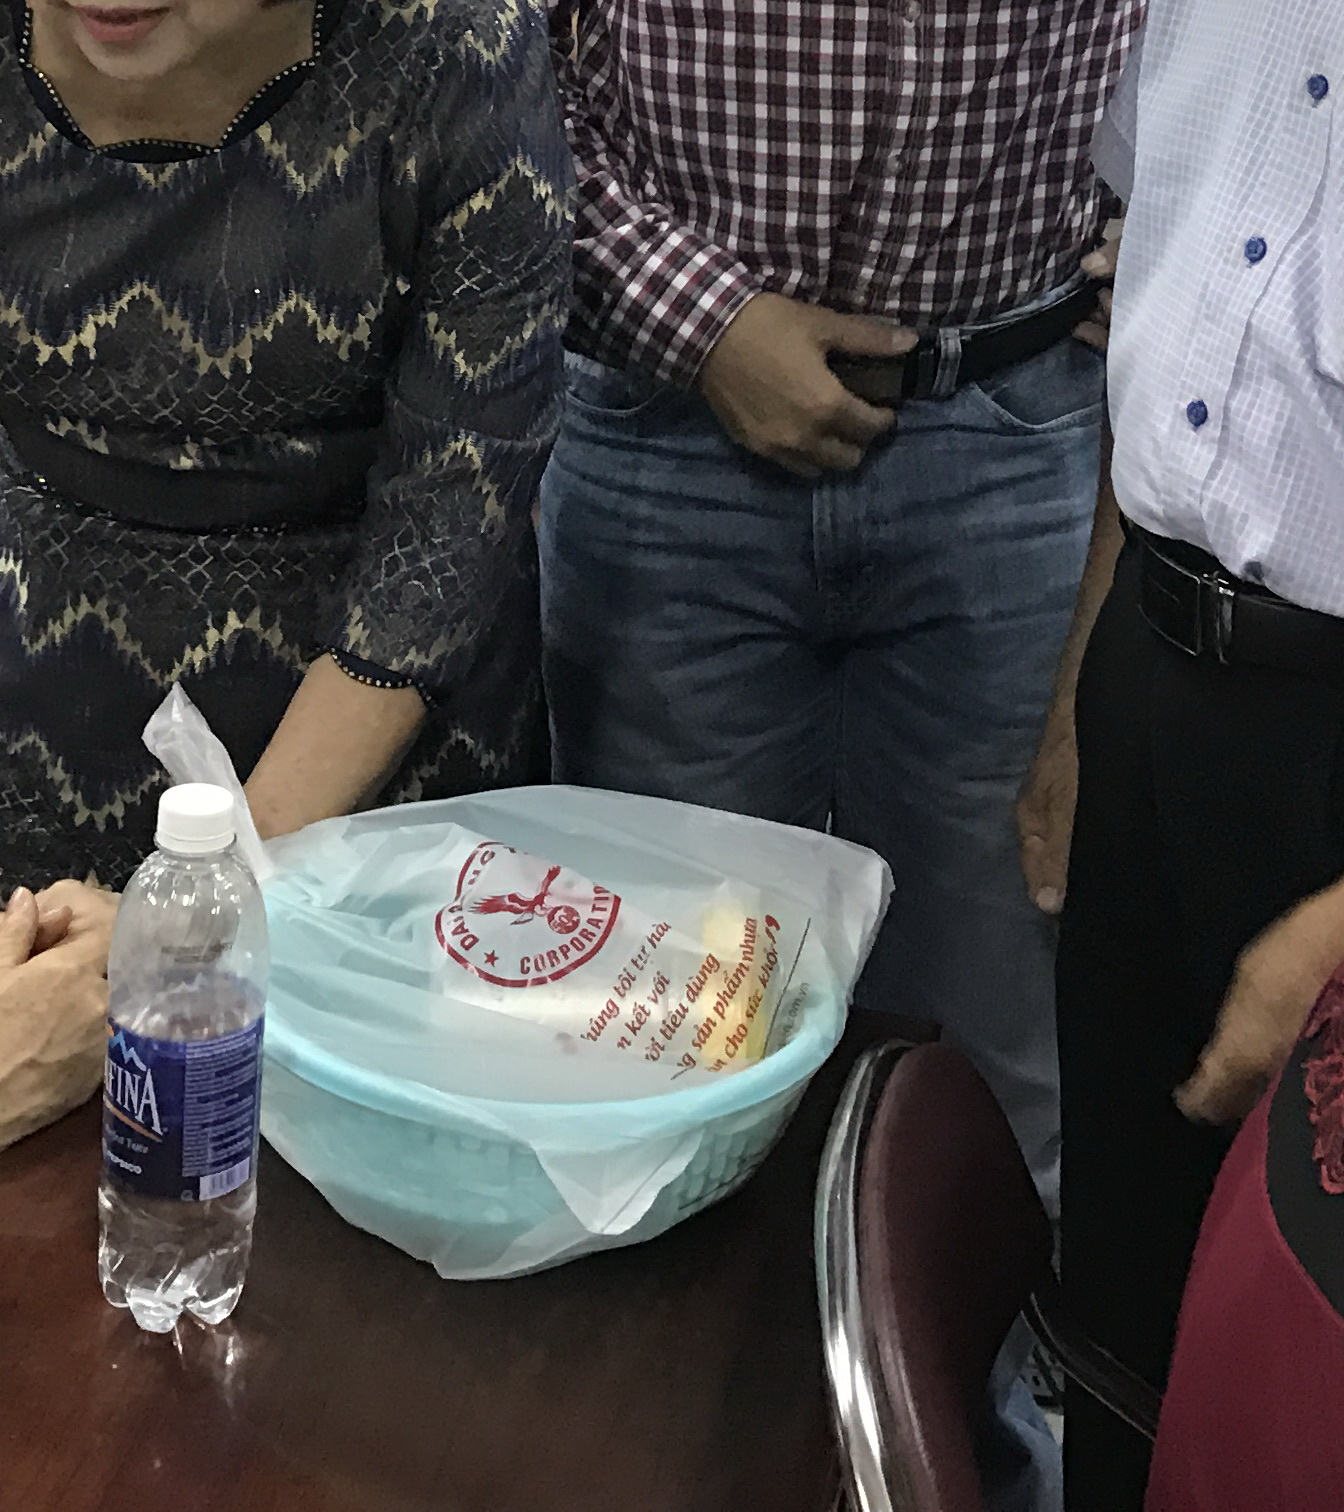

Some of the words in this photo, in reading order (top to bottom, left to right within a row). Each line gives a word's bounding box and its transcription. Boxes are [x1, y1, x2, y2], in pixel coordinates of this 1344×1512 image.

[613, 967, 636, 997] tôi
[647, 922, 671, 948] hà
[625, 1001, 651, 1036] kết
[647, 971, 670, 1004] với
[659, 1003, 689, 1040] tiêu
[685, 953, 720, 1003] dùng
[691, 1014, 716, 1051] sản
[724, 1023, 748, 1059] cho
